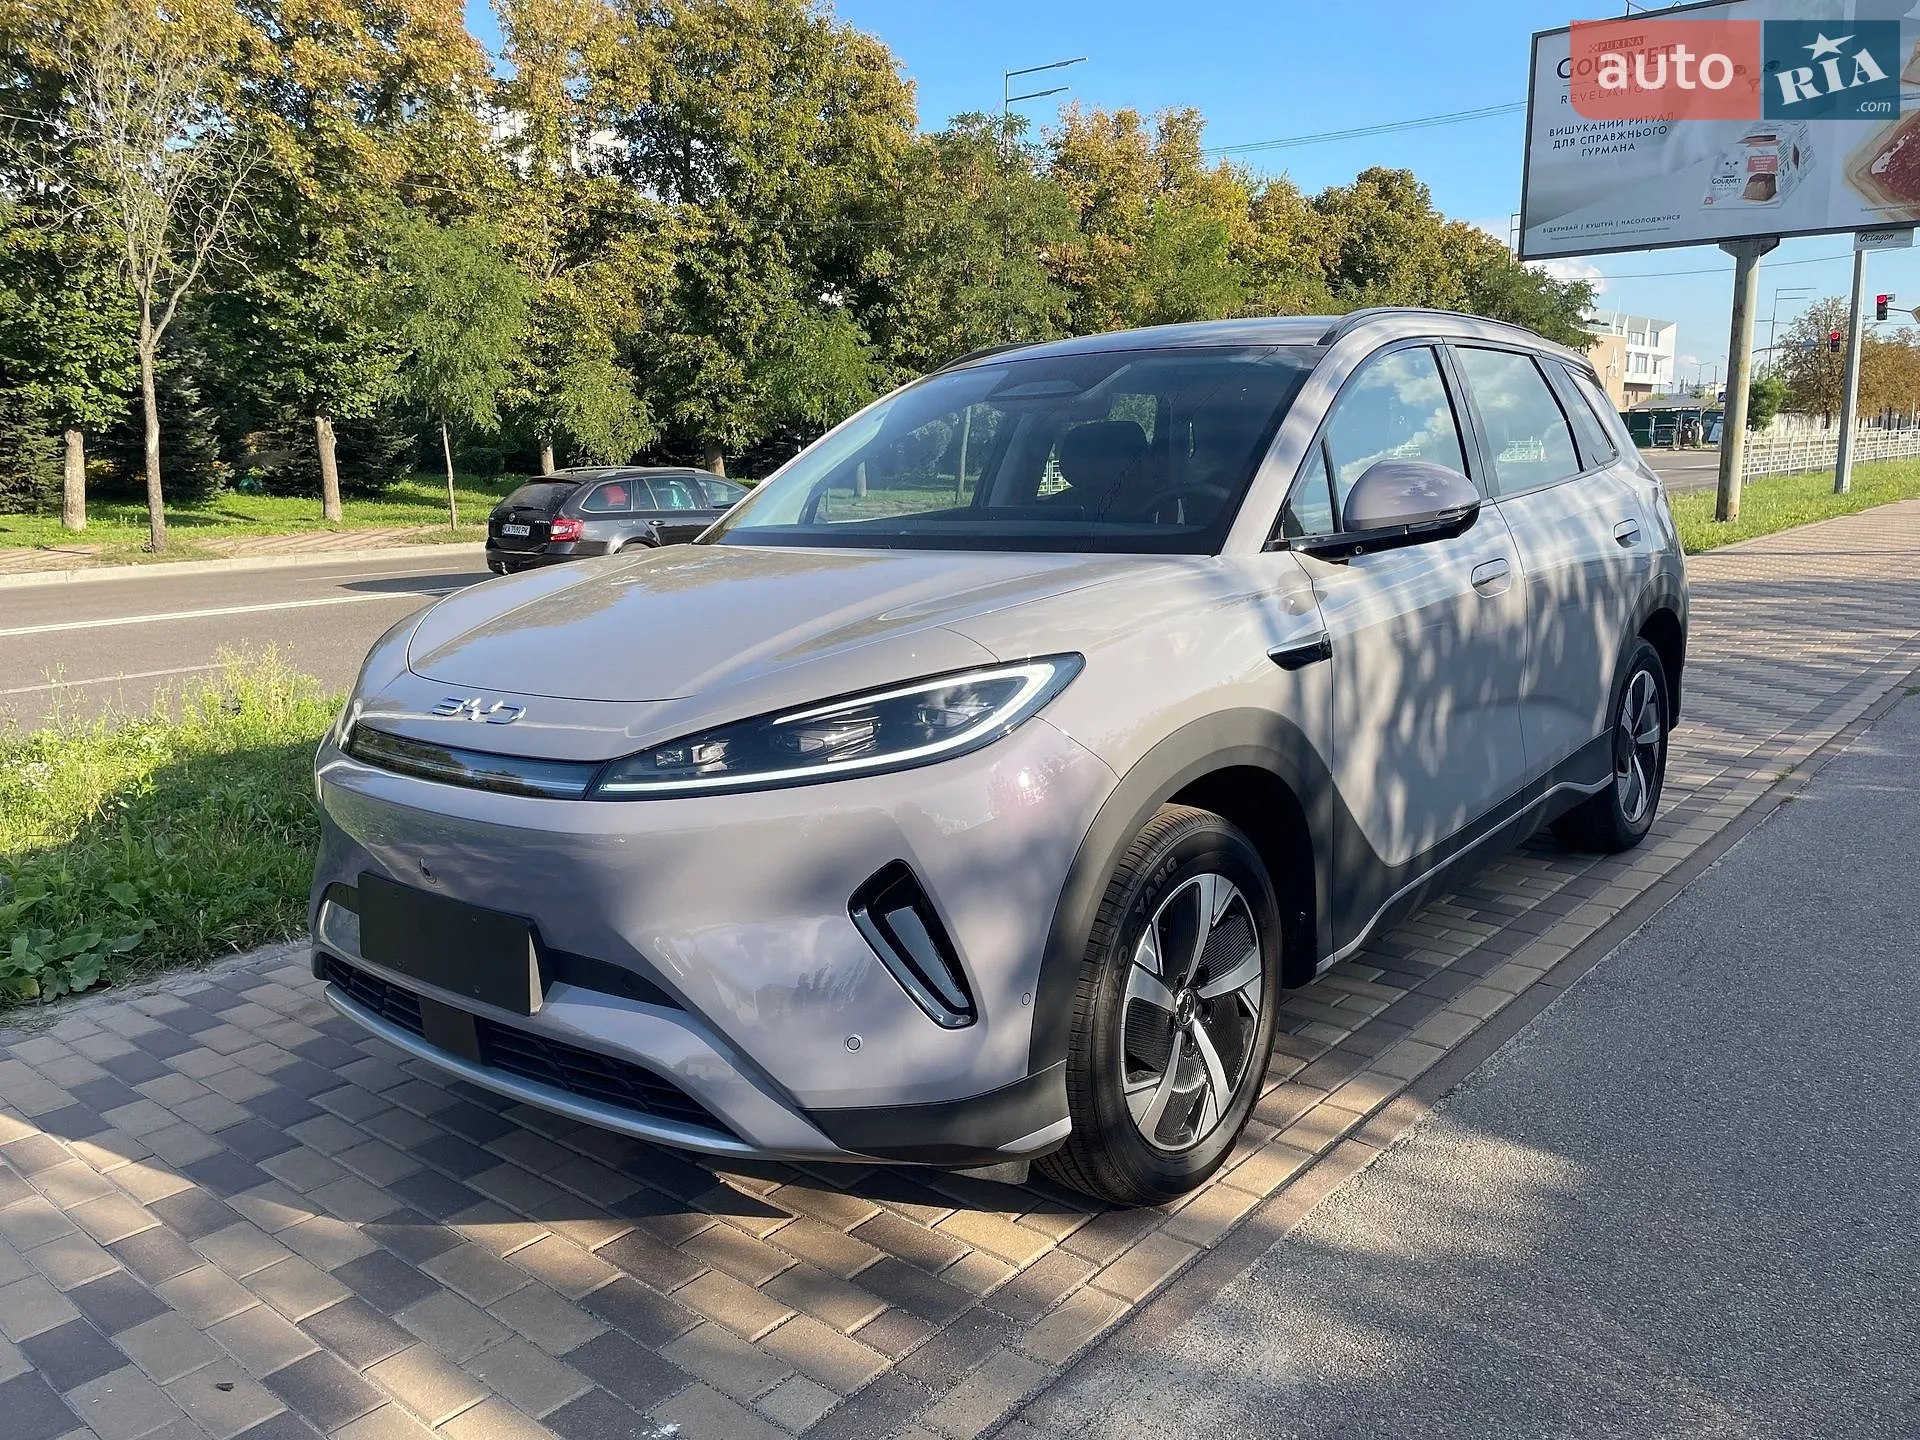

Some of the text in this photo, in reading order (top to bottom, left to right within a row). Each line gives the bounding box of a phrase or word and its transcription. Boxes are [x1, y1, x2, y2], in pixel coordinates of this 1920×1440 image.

[1599, 37, 1643, 51] PURINA
[1549, 112, 1674, 137] ВИШУКАНИЙ РИТУАЛ
[1553, 125, 1668, 150] ДЛЯ СПРАВЖНЬОГО
[1581, 143, 1636, 157] ГУРМАНА
[1859, 233, 1895, 243] Octagon
